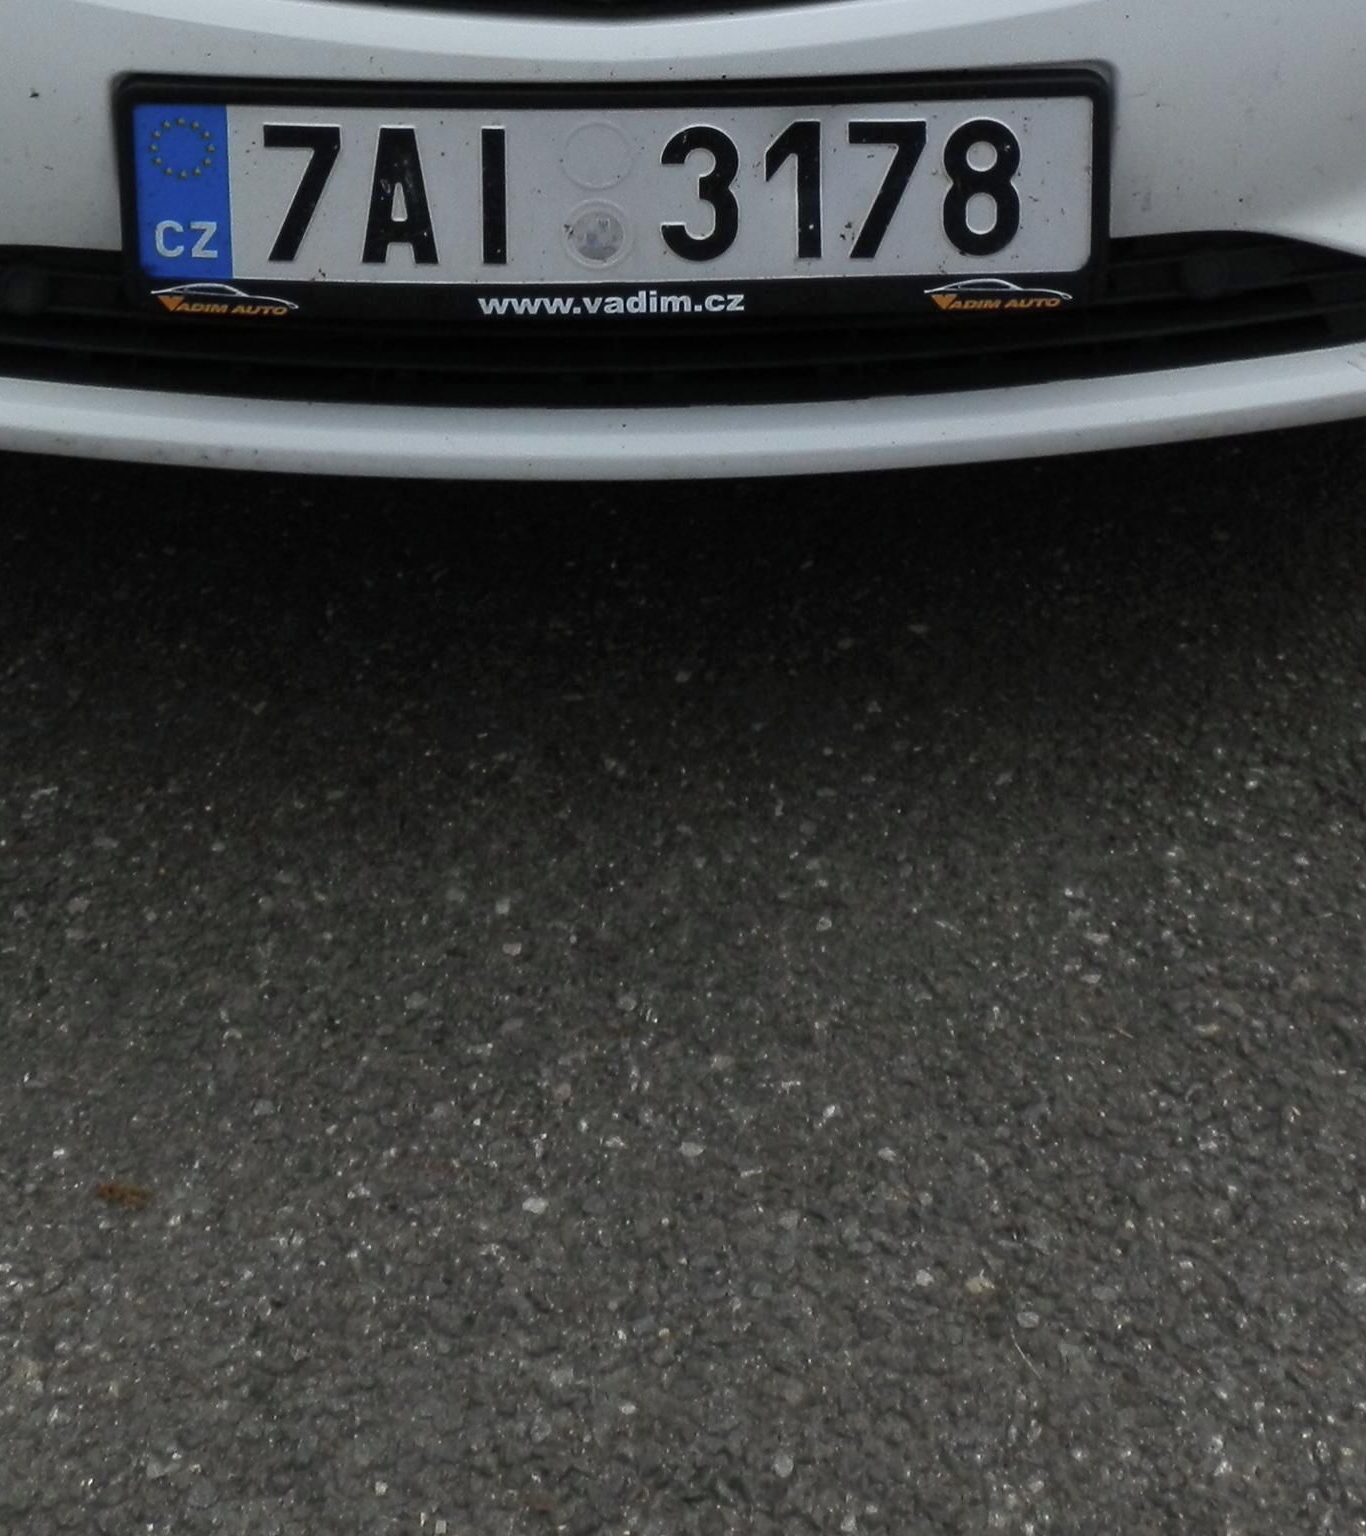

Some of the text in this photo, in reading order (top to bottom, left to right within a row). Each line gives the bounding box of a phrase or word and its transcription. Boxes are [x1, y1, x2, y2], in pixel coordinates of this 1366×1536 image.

[262, 117, 1022, 265] 7AI 3178
[154, 219, 219, 259] CZ
[156, 294, 289, 316] VADIM AUTO
[478, 290, 745, 315] www.vadim.cz
[930, 293, 1062, 310] VADIM AUTO
